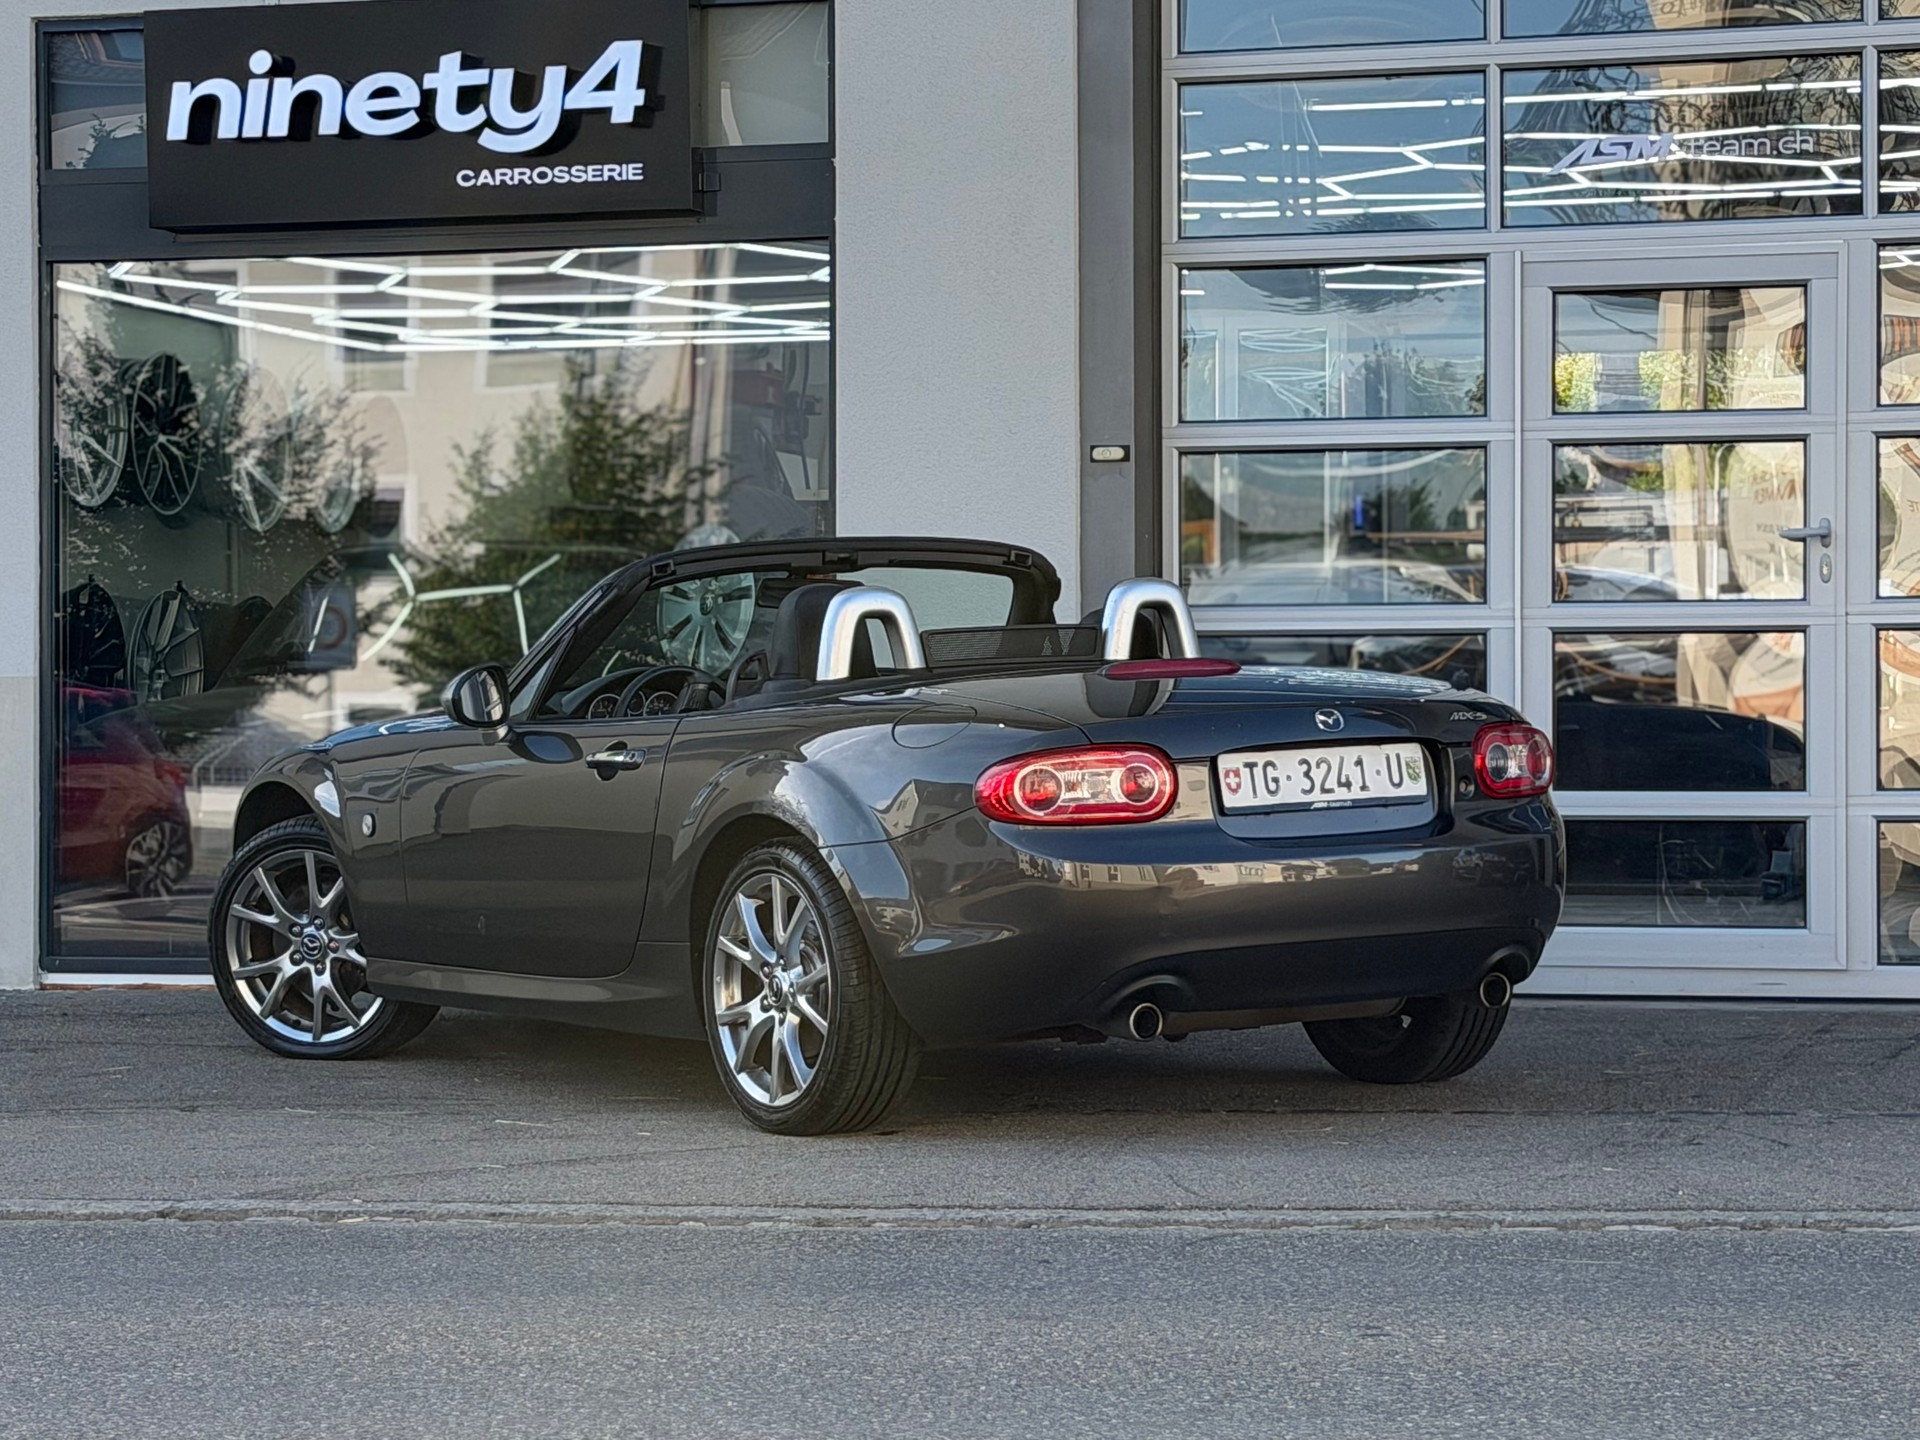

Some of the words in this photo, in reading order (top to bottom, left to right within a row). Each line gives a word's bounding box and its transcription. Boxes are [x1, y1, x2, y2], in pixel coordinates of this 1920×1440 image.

[166, 39, 645, 153] ninety4
[1549, 133, 1674, 174] ASM
[1688, 129, 1813, 157] team.ch
[456, 163, 644, 187] CARROSSERIE
[1450, 711, 1488, 720] MX-5
